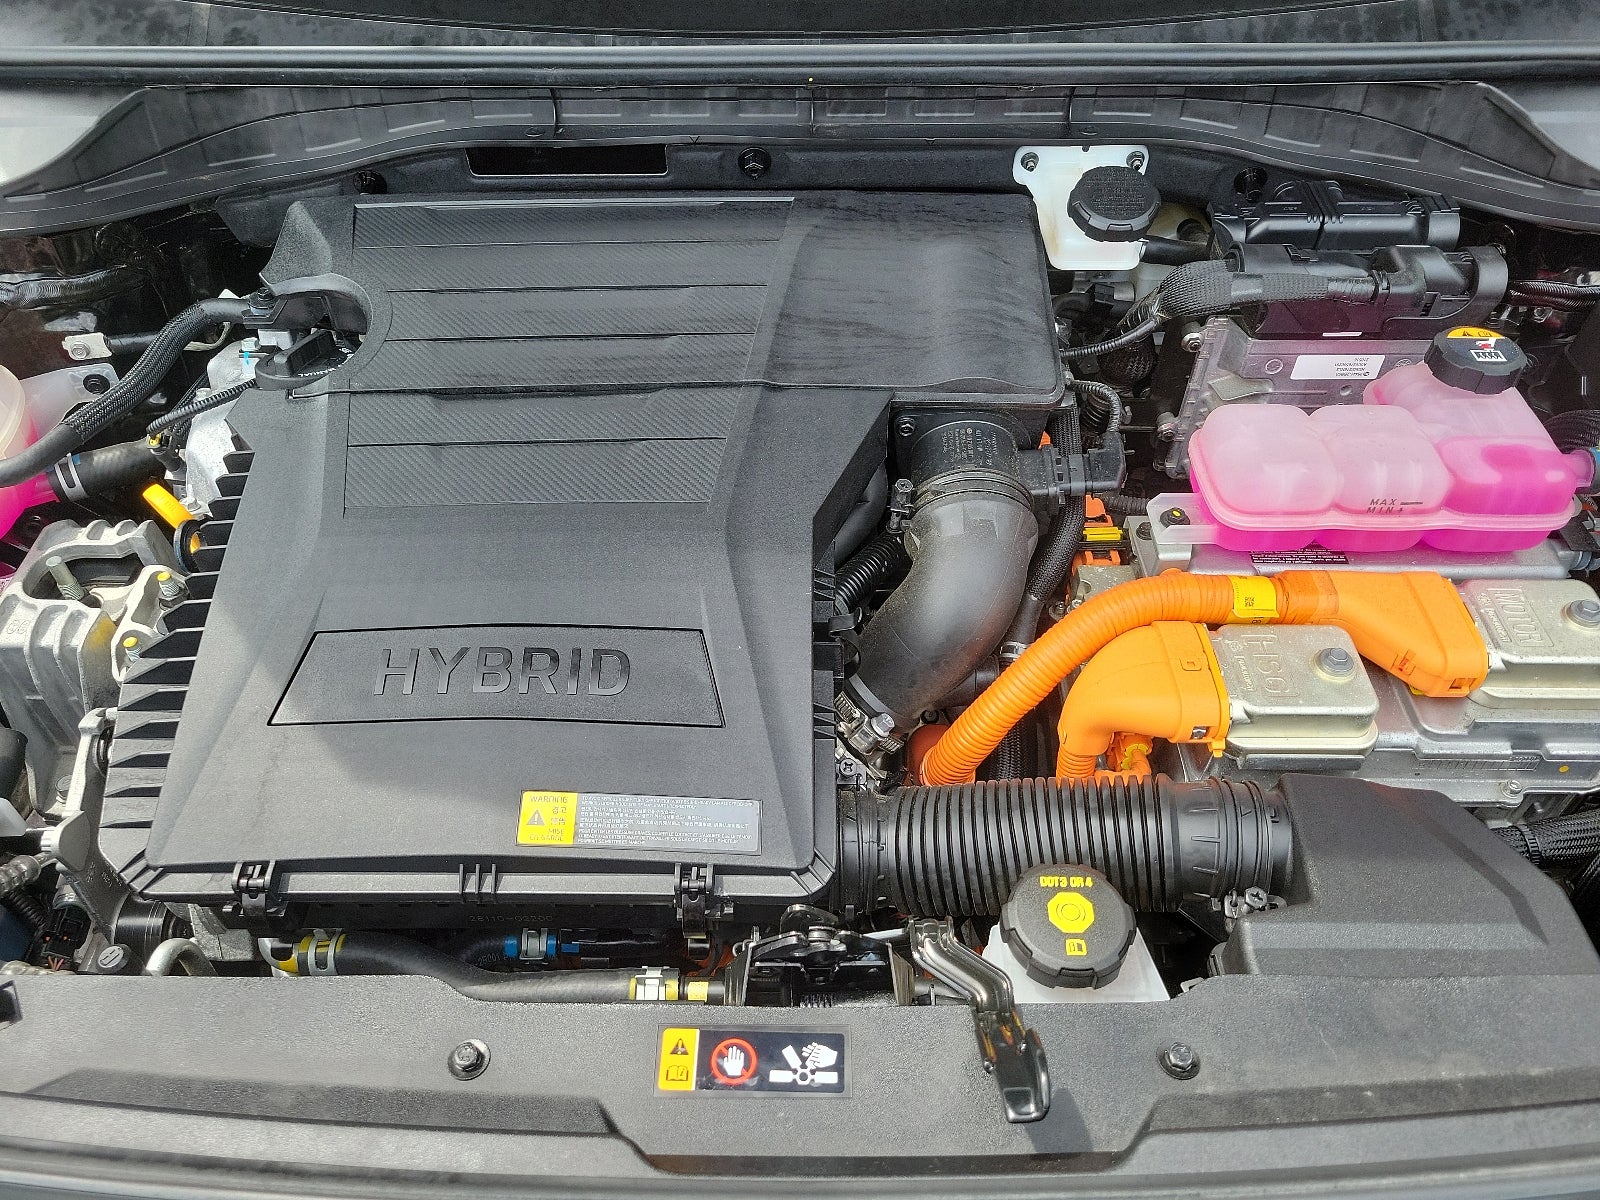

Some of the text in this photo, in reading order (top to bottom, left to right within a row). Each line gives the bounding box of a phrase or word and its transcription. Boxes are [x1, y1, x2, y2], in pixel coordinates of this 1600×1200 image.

[1369, 498, 1398, 506] MAX
[1366, 506, 1394, 514] MIN
[1494, 592, 1544, 644] MOTOR
[373, 646, 631, 696] HYBRID
[529, 795, 569, 804] WARNING
[1069, 876, 1085, 888] OR
[1085, 876, 1094, 888] 4
